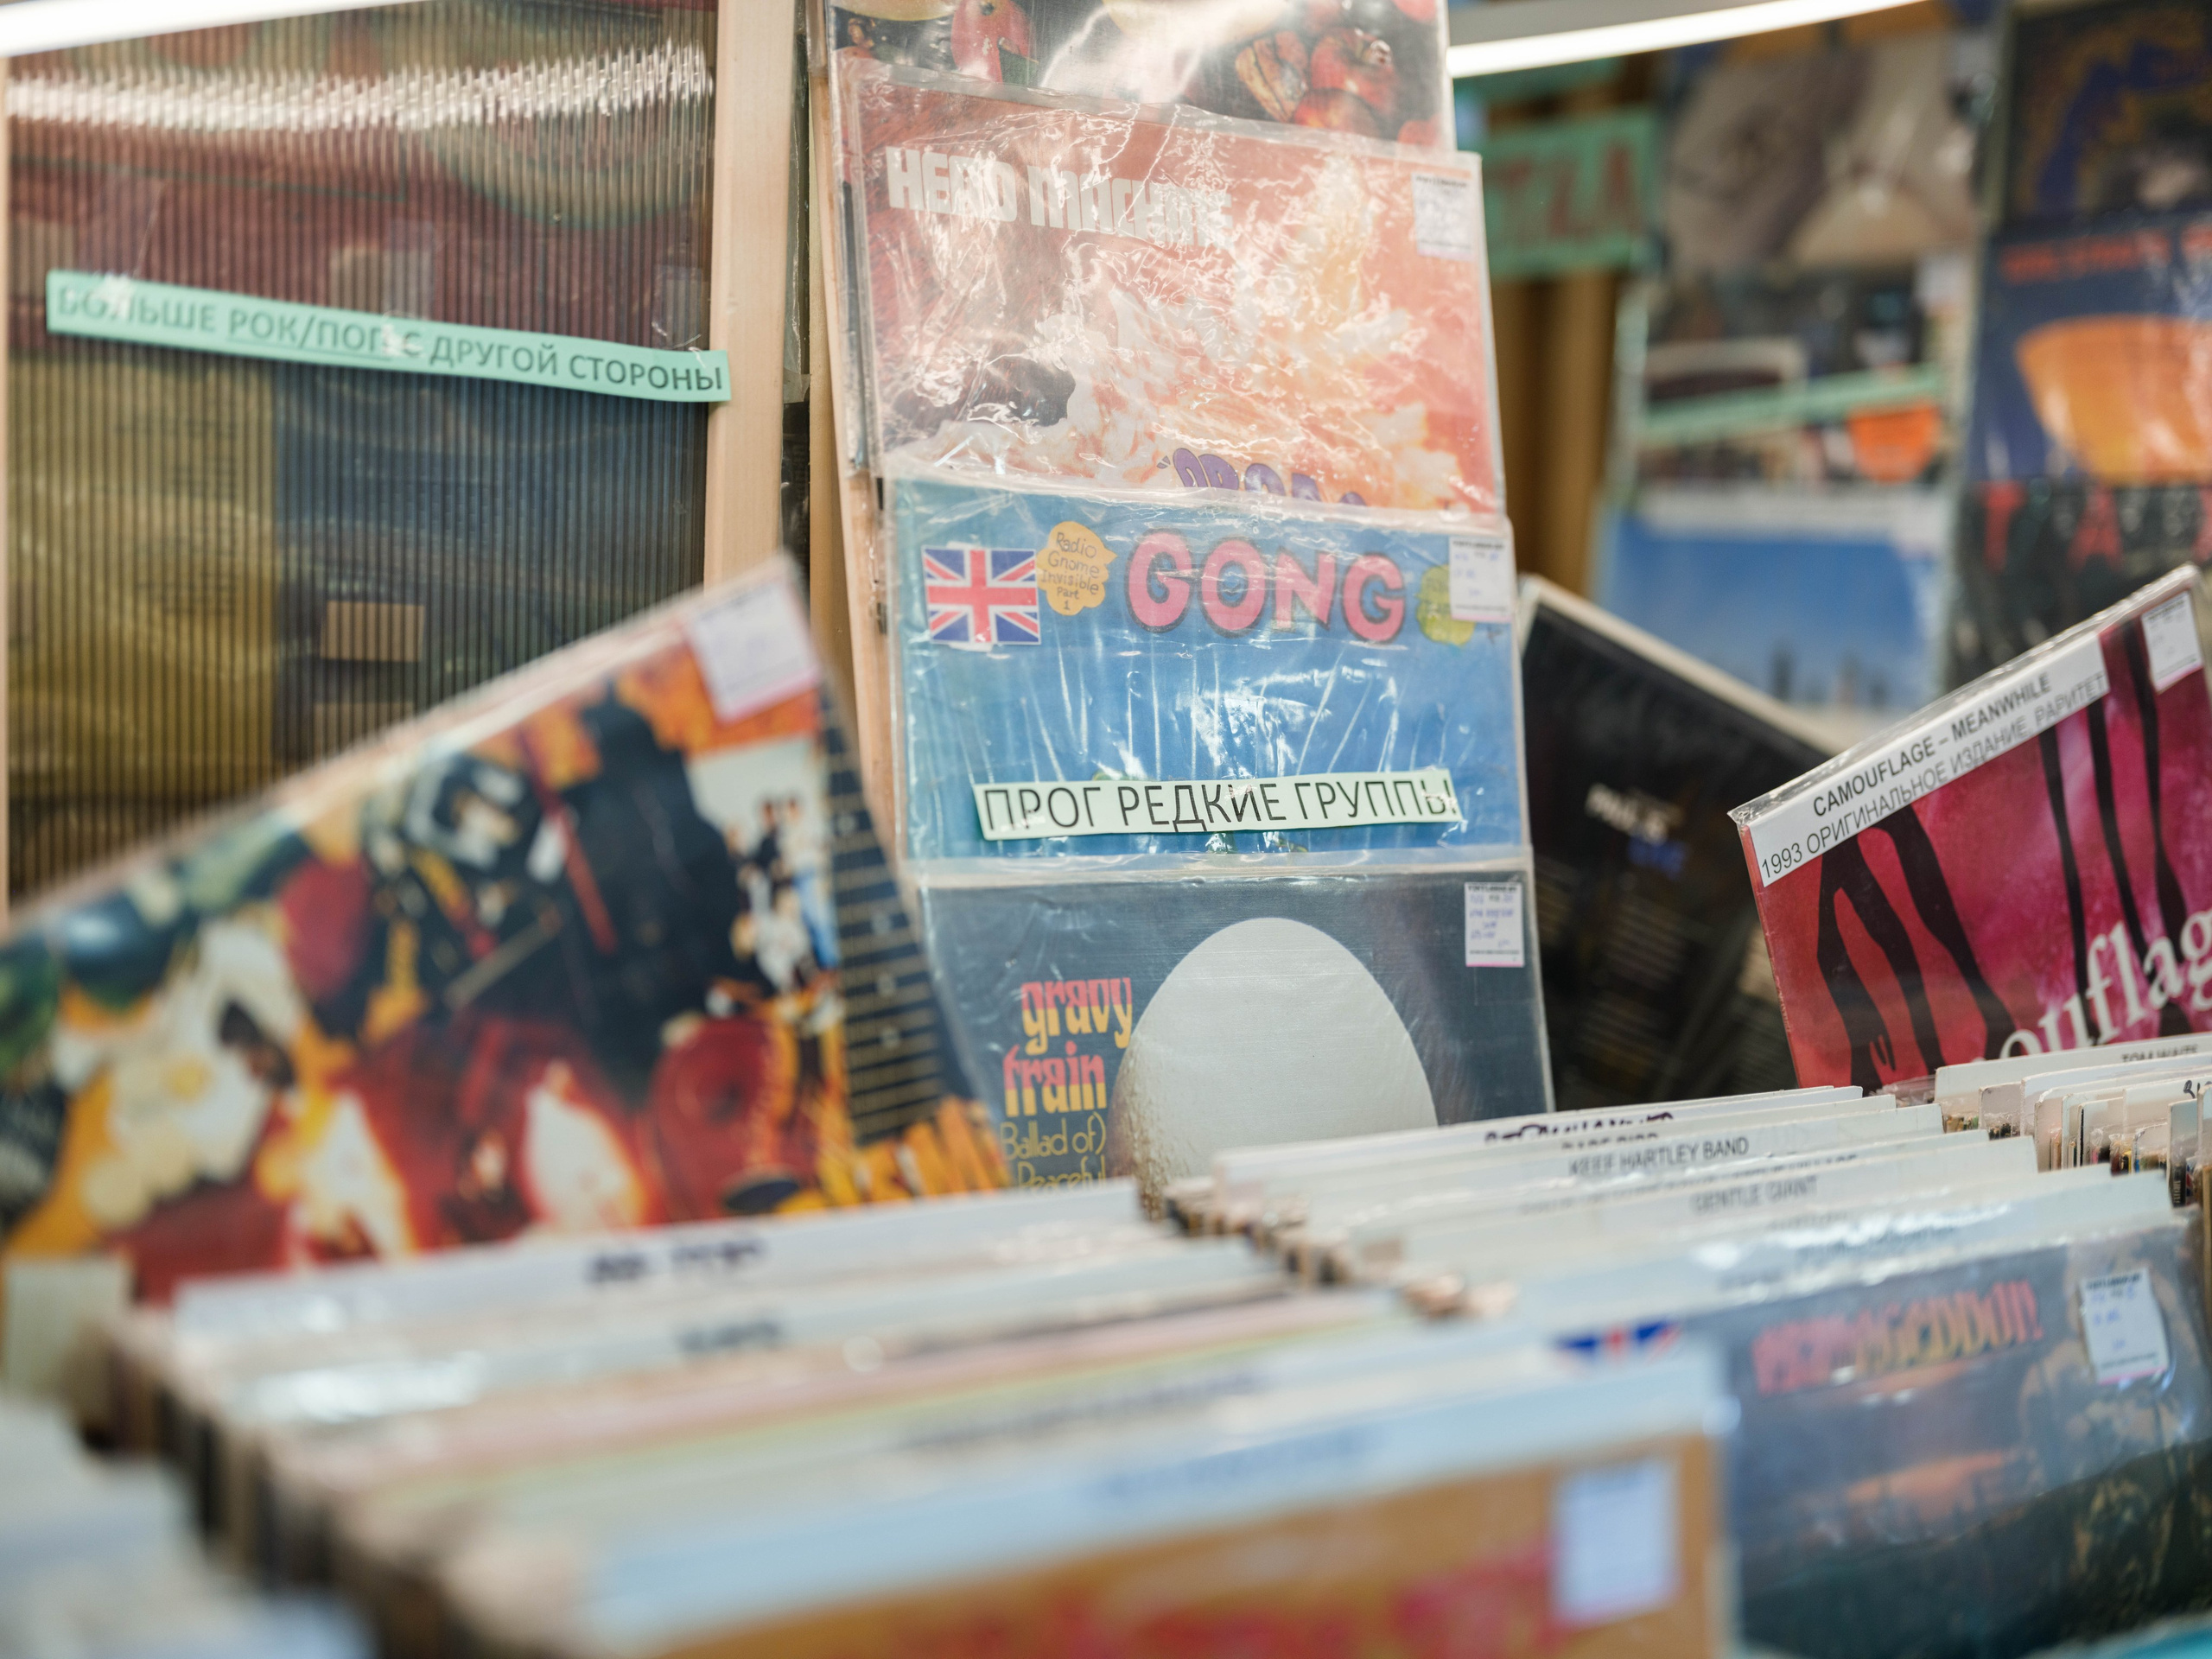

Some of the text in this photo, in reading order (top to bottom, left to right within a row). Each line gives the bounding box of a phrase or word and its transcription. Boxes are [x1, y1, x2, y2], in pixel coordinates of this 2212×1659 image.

[886, 146, 1017, 223] HEAD
[429, 335, 557, 377] ДРУГОЙ
[569, 354, 722, 391] СТОРОНЫ
[1048, 550, 1100, 579] Gnome
[1057, 531, 1097, 559] Radio
[1041, 569, 1100, 595] Invisible
[1125, 528, 1407, 645] GONG
[1813, 736, 1936, 817] CAMOUFLAGE
[1951, 671, 2051, 742] MEANWHILE
[1761, 842, 1803, 880] 1993
[1806, 762, 1949, 854] ОРИГИНАЛЬНОЕ
[2034, 671, 2107, 728] РАРИТЕТ
[983, 779, 1459, 833] ПРОГ РЕДКИЕ ГРУППЫ
[1020, 977, 1133, 1056] gravy
[1002, 1040, 1107, 1117] train
[1000, 1117, 1069, 1160] Ballad
[1618, 1142, 1700, 1168] HARTLEY
[1702, 1136, 1750, 1160] BAND
